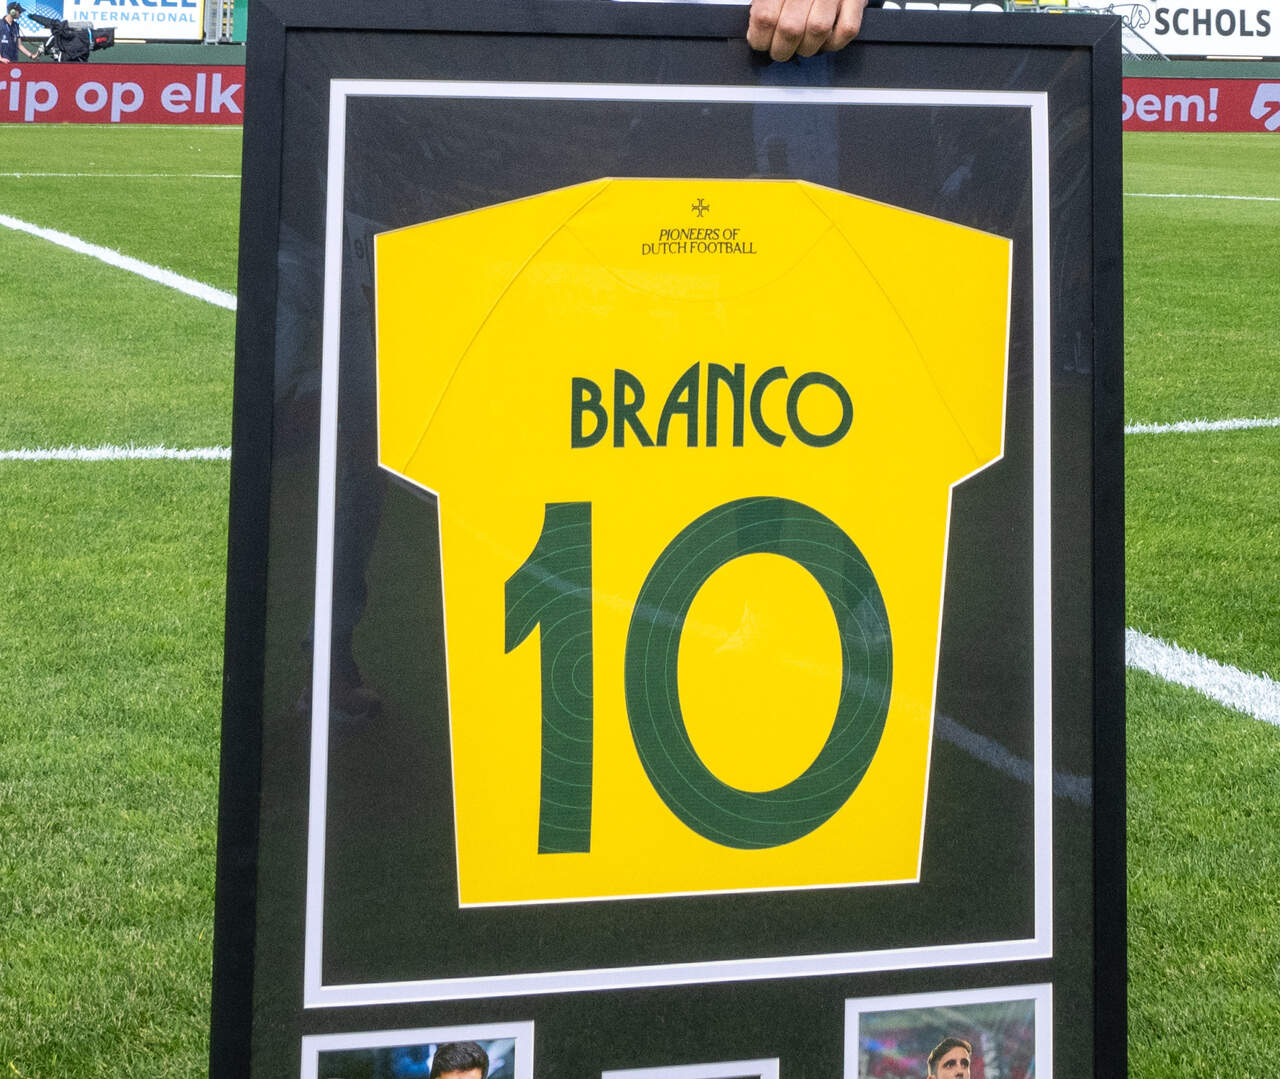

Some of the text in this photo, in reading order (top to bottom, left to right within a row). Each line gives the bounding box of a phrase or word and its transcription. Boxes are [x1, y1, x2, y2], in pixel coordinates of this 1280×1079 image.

[73, 10, 196, 23] INTERNATIONAL
[1154, 7, 1271, 37] SCHOLS
[75, 80, 144, 123] op
[161, 72, 242, 114] elk
[641, 241, 757, 256] DUTCH FOOTBALL
[658, 228, 741, 242] PIONEERS OF
[570, 360, 854, 449] BRANCO
[504, 495, 894, 856] 10
